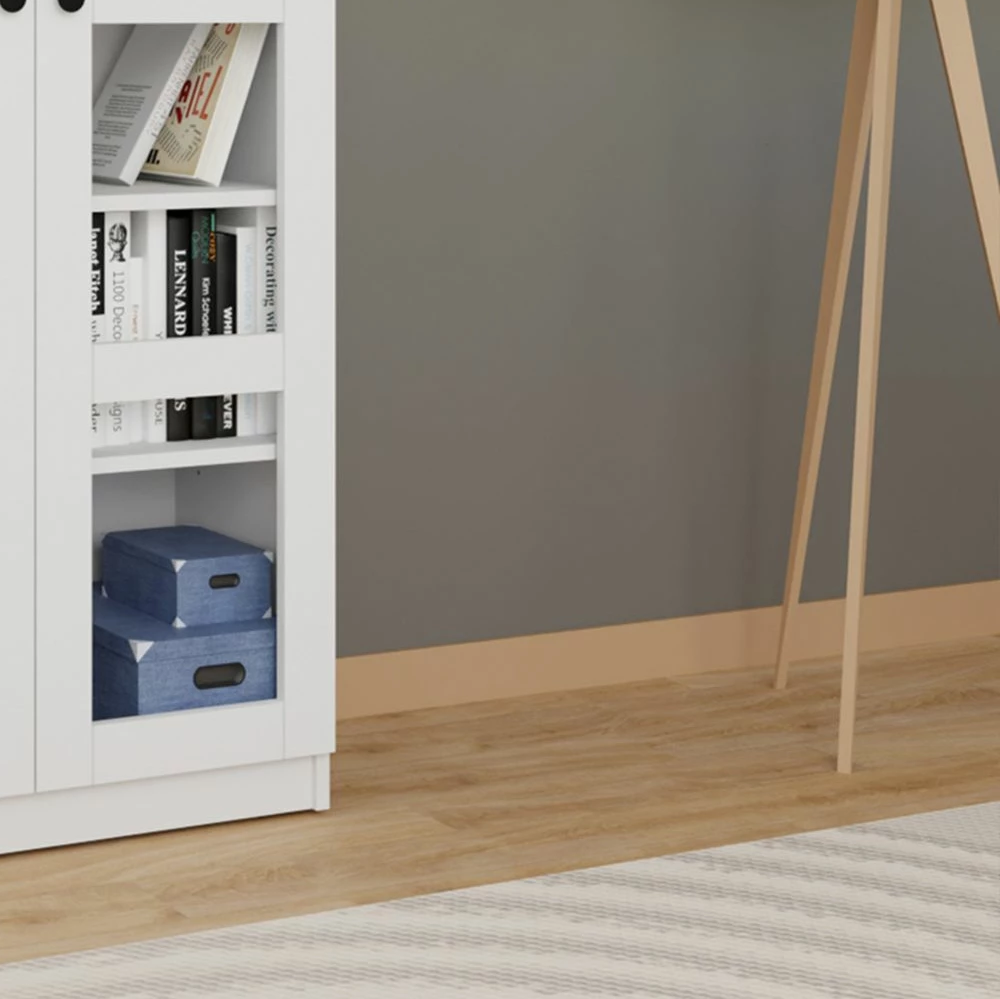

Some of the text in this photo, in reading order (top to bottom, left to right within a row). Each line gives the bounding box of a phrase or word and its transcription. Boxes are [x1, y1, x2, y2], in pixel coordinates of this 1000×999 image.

[174, 249, 188, 335] LENNARD
[201, 277, 210, 296] Kim
[263, 226, 277, 307] Decorating
[112, 271, 125, 340] 1100 Deco
